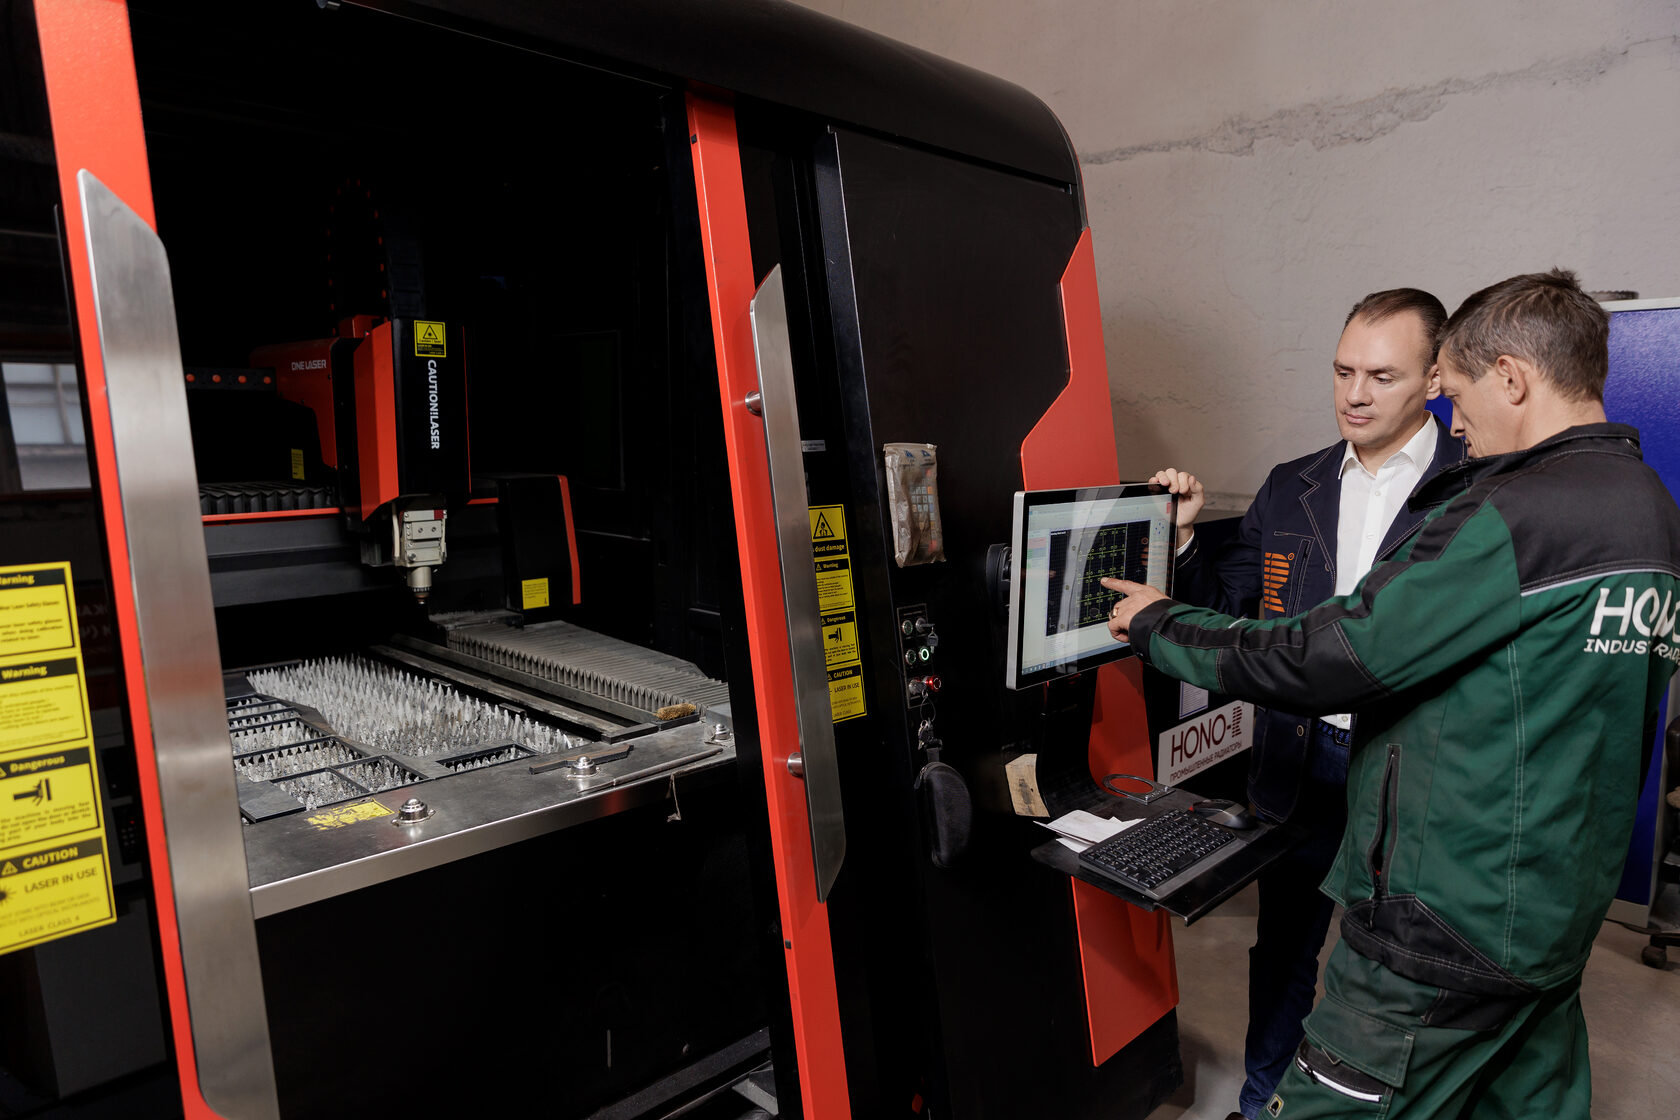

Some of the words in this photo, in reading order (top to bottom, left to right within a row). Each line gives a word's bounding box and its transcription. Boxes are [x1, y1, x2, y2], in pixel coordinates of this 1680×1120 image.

[826, 544, 845, 552] damage
[0, 574, 35, 586] arning
[2, 665, 48, 680] Warning
[833, 669, 853, 679] CAUTION
[9, 755, 66, 773] Dangerous
[1169, 754, 1214, 782] ПРОМЫШЛЕННЫЕ
[1213, 740, 1243, 760] РАДИАТОРЫ
[22, 846, 79, 869] CAUTION
[24, 876, 59, 894] LASER
[62, 873, 74, 884] IN
[76, 867, 98, 880] USE
